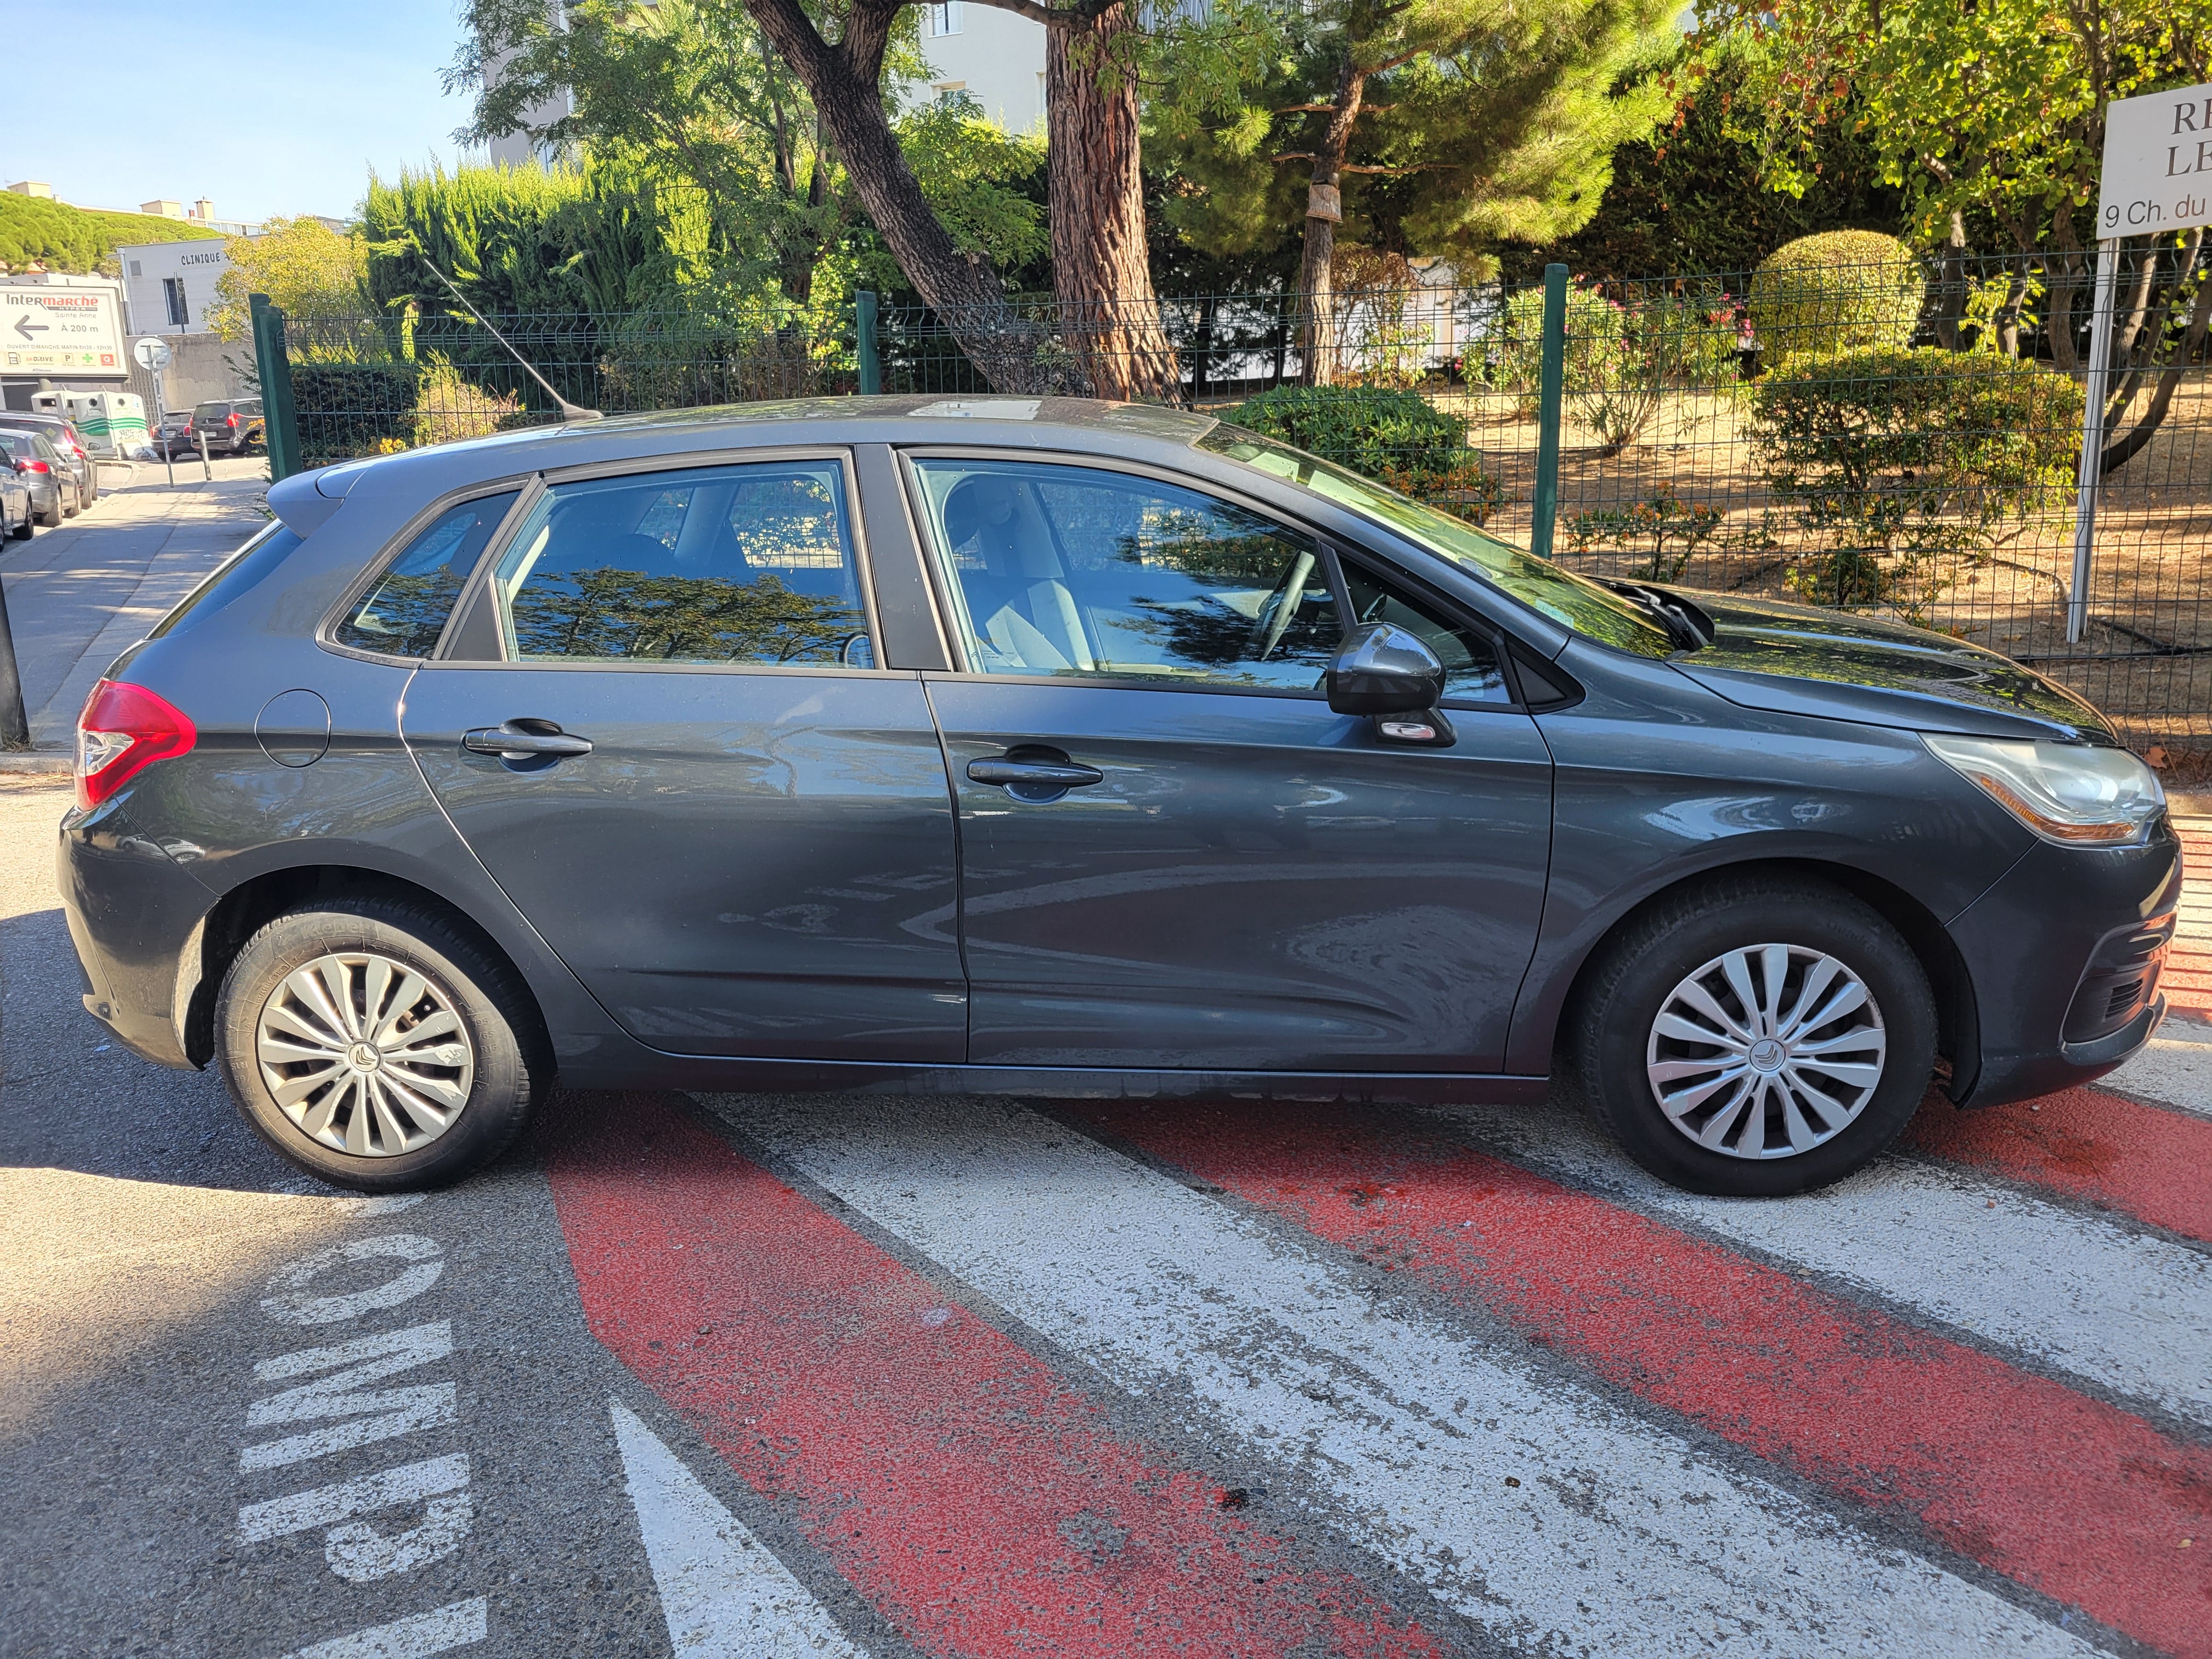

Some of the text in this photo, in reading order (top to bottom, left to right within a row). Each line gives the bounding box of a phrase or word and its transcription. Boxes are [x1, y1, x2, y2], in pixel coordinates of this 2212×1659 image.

[2165, 140, 2212, 177] LE
[2105, 194, 2205, 228] 9 Ch. du
[181, 252, 221, 266] CLINIQUE
[7, 294, 98, 310] Intermarché
[61, 323, 68, 332] À
[300, 919, 366, 939] Kleber
[473, 1018, 490, 1027] 195
[480, 1043, 498, 1054] R15
